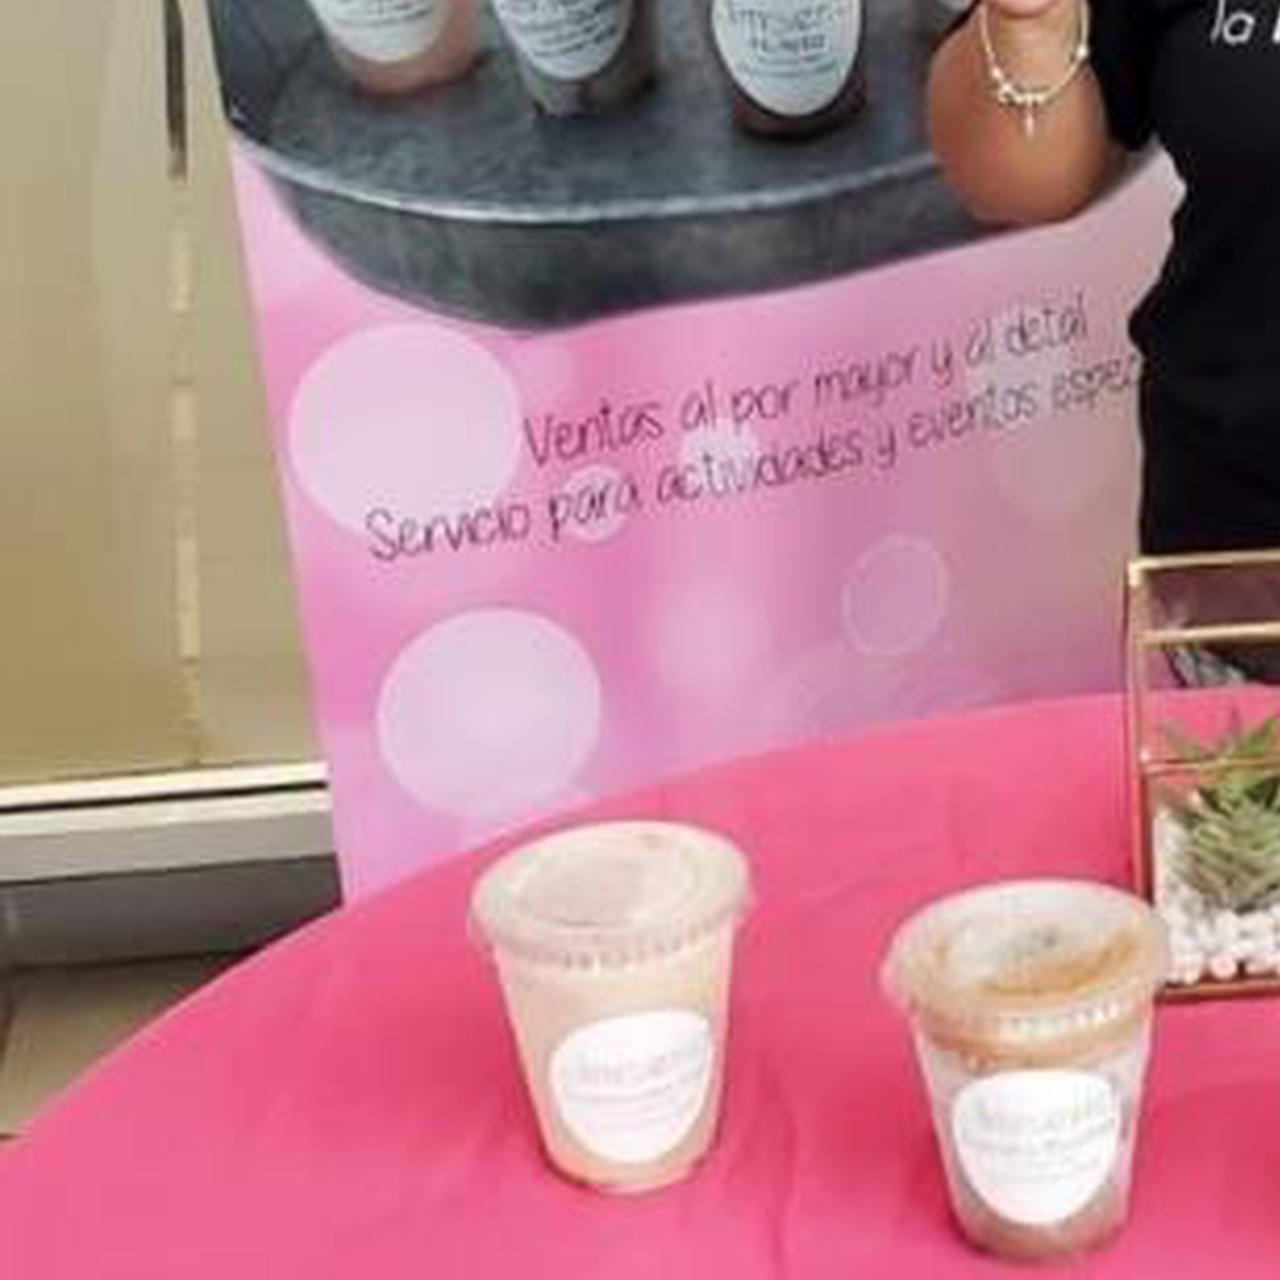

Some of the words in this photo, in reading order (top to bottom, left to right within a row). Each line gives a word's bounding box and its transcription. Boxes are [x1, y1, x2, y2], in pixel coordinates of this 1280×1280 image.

[364, 506, 531, 562] Servicio
[548, 475, 643, 542] para
[656, 423, 864, 503] actividades
[877, 423, 898, 471] y
[908, 381, 1038, 448] eventos
[1051, 350, 1139, 410] espec
[522, 400, 663, 467] Ventas
[680, 378, 716, 431] al
[732, 380, 799, 433] por
[813, 347, 917, 407] mayor
[930, 338, 953, 389] y
[963, 316, 993, 368] al
[1003, 294, 1087, 357] detal
